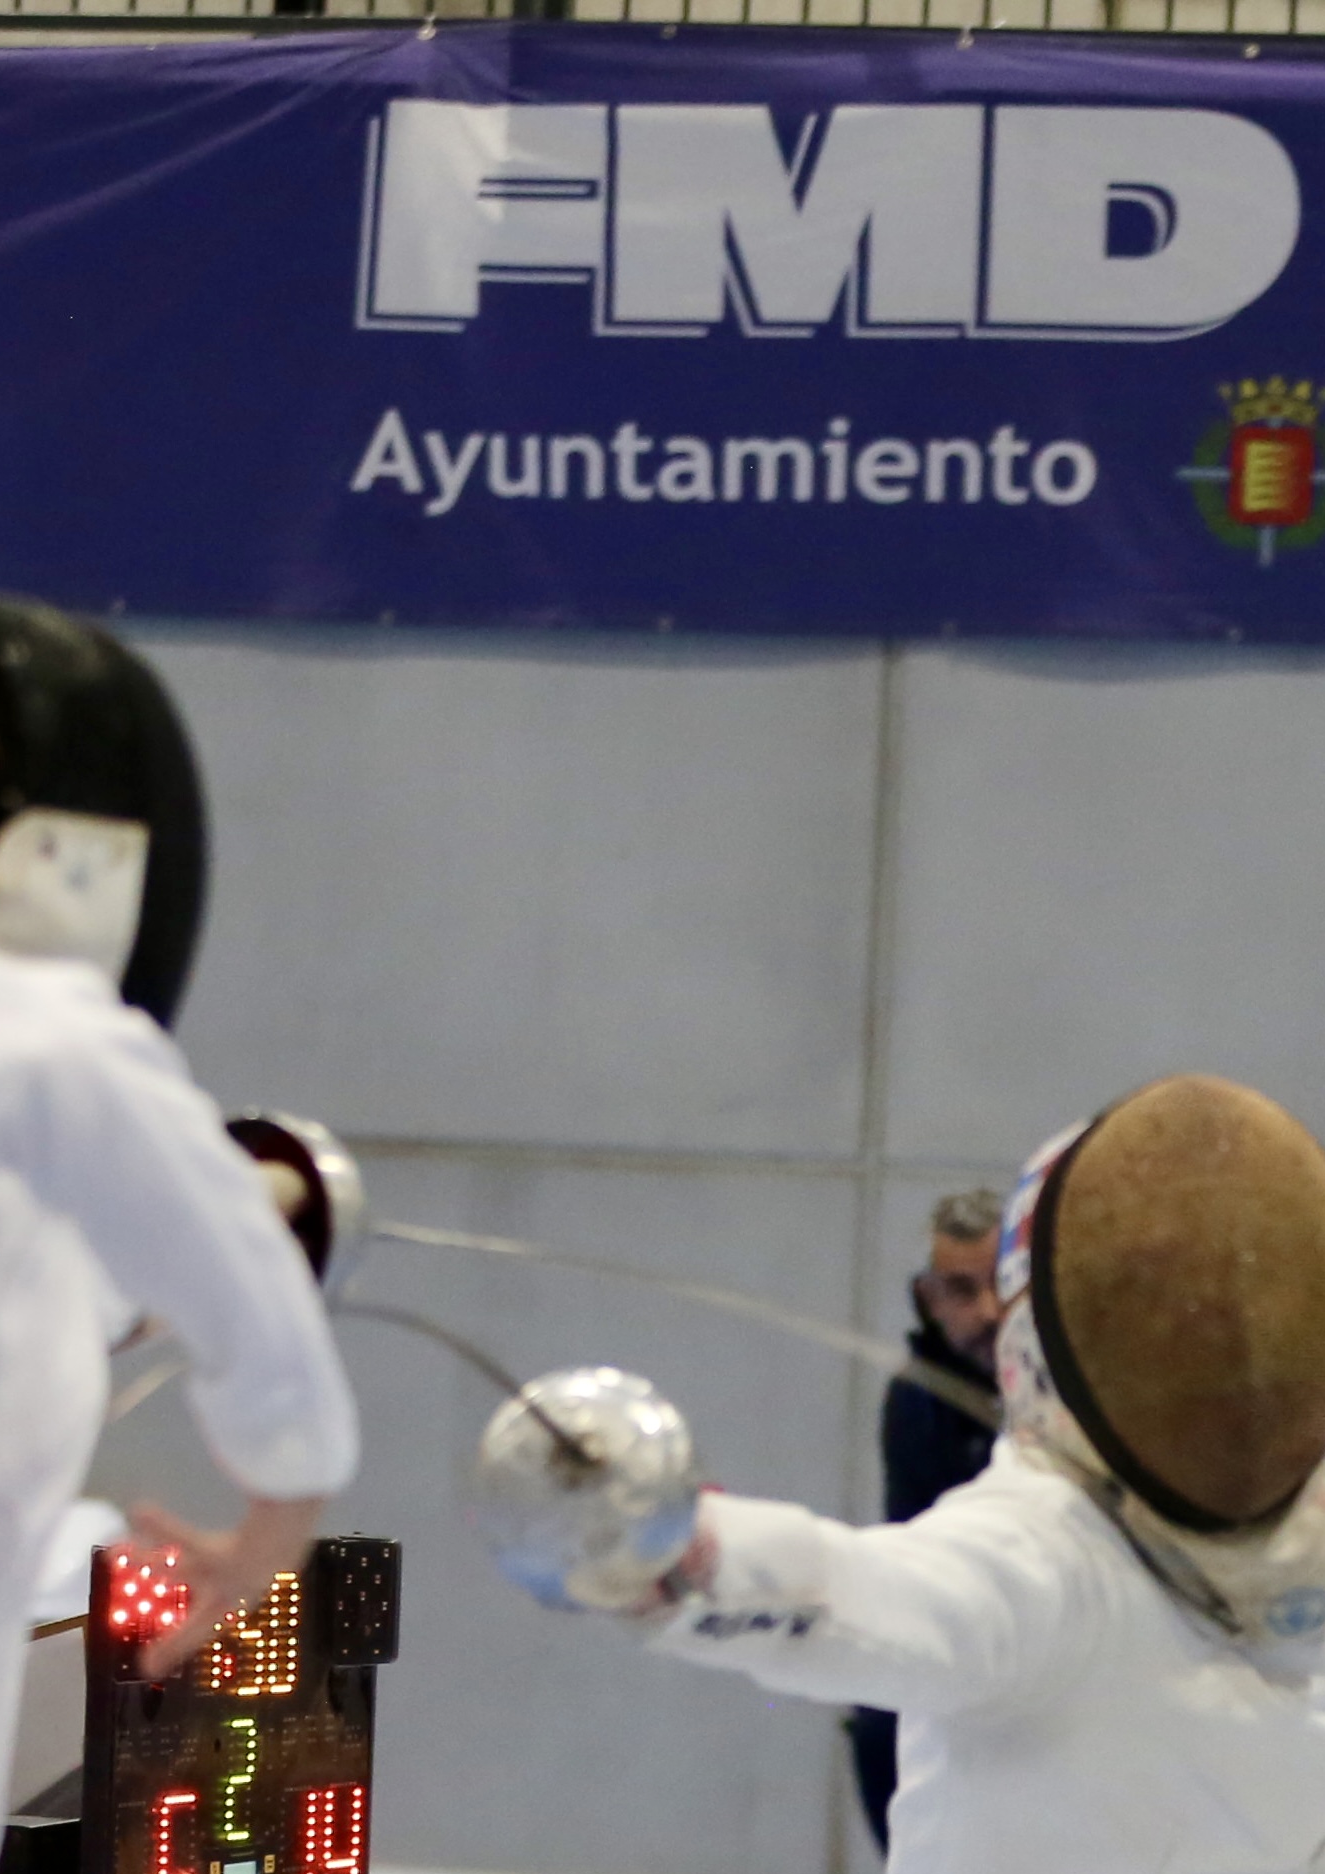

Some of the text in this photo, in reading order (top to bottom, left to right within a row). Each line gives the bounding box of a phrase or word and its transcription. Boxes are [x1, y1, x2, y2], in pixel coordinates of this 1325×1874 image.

[355, 97, 1301, 342] FMD
[350, 408, 1099, 517] Ayuntamiento
[224, 1717, 258, 1841] 2
